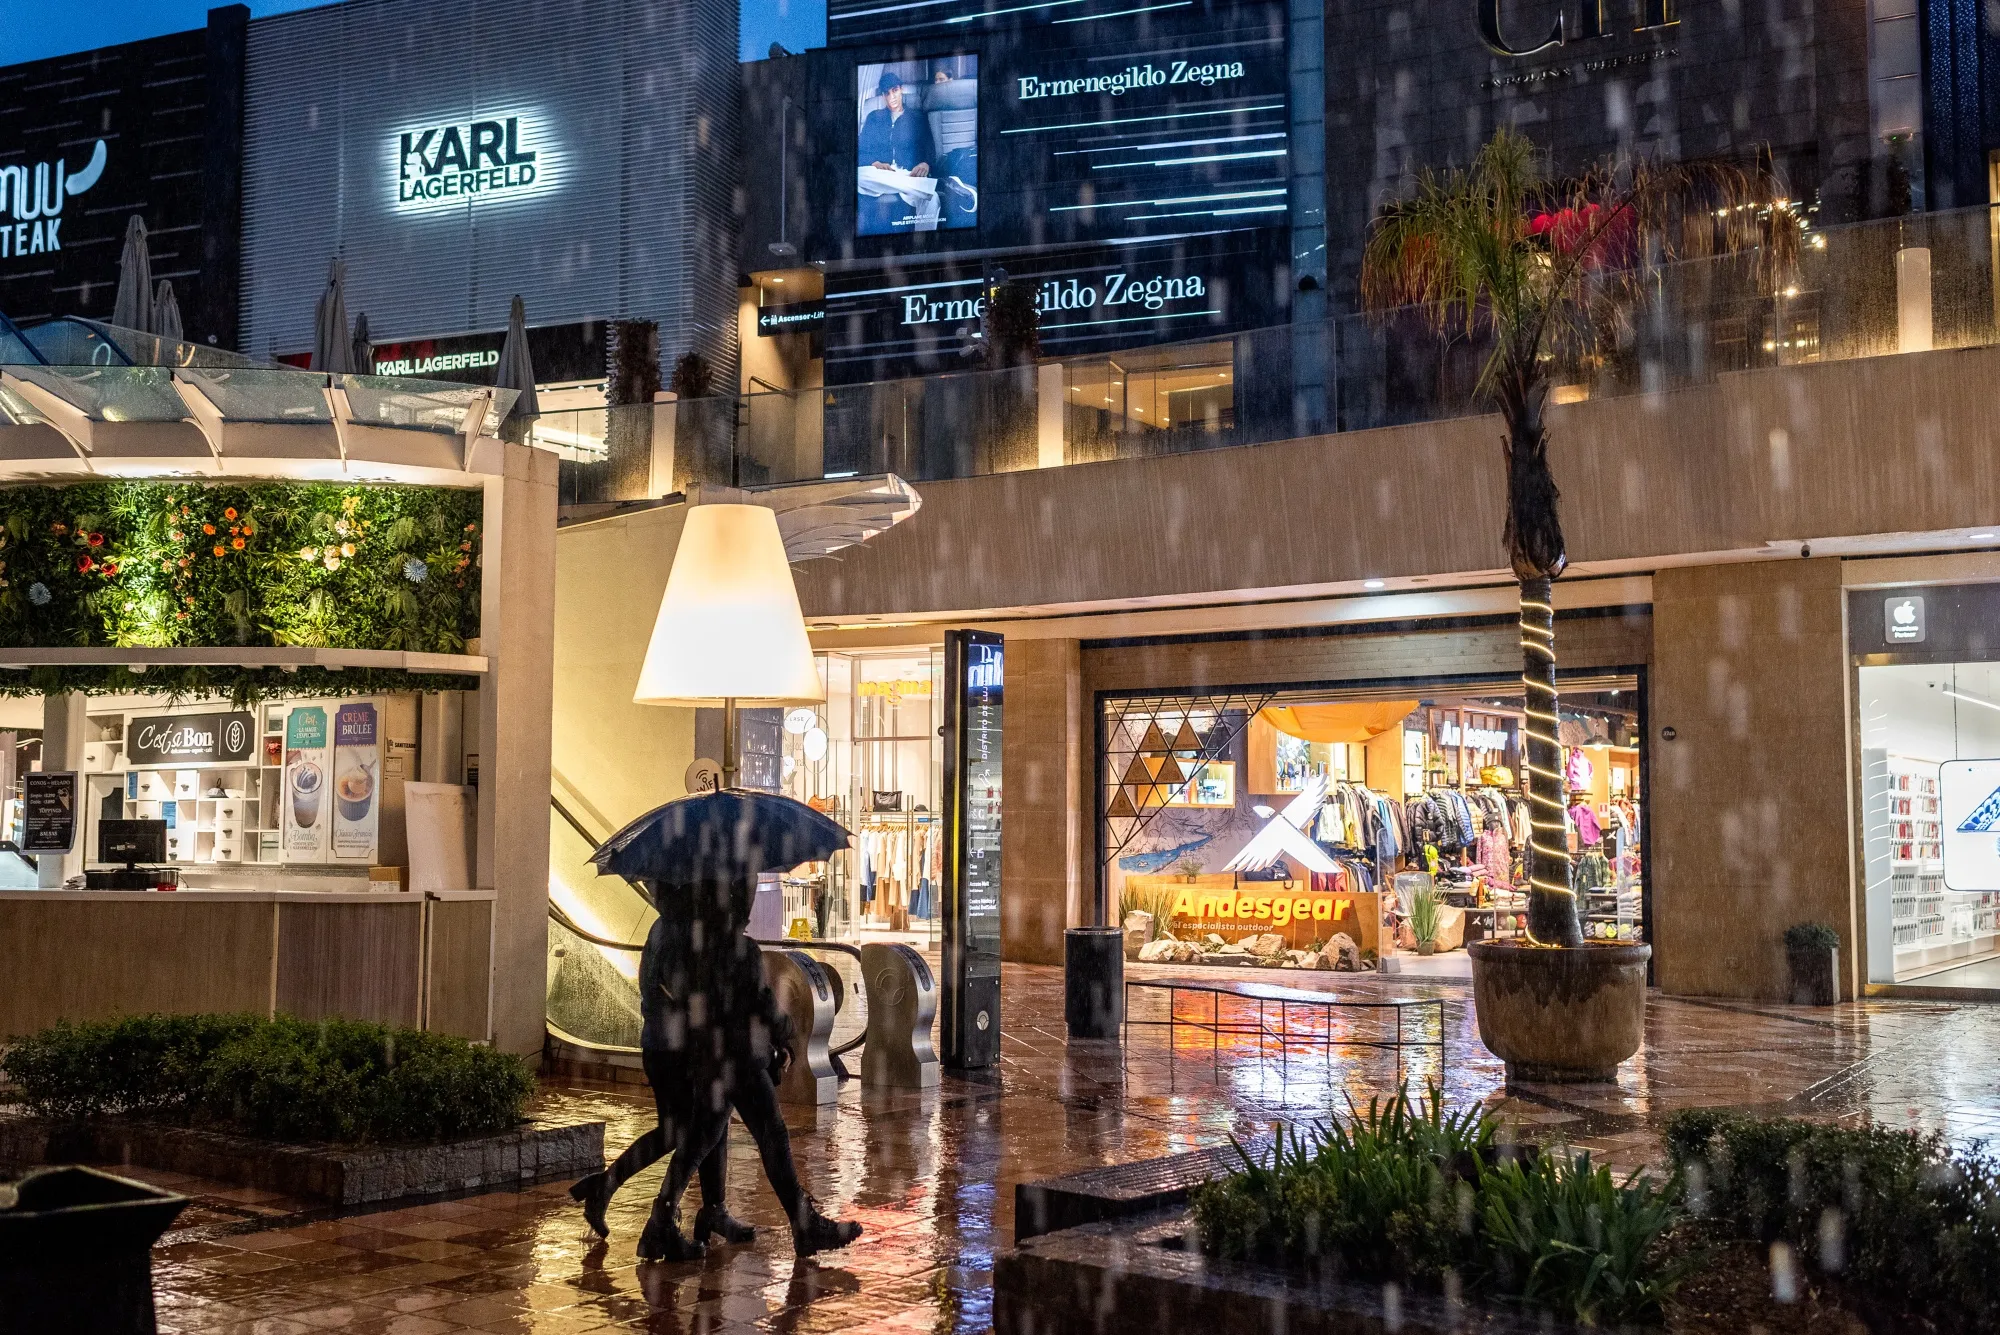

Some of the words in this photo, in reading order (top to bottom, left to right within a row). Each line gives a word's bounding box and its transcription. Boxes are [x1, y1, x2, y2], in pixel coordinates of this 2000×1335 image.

[1018, 65, 1166, 100] Ermenegildo
[1169, 60, 1245, 87] Zegna
[400, 117, 536, 180] KARL
[399, 164, 536, 201] LAGERFELD
[0, 218, 61, 258] TEAK
[900, 278, 1097, 325] Ermeildo
[1102, 273, 1205, 310] Zegna
[375, 359, 414, 376] KARL
[415, 350, 500, 374] LAGERFELD
[857, 679, 933, 706] magma
[342, 710, 369, 722] CRÈME
[342, 722, 373, 735] BRÛLÉE
[182, 727, 213, 747] Bon
[1172, 889, 1350, 927] Andesgear
[1182, 921, 1236, 931] especialista
[1237, 923, 1273, 932] outdoor
